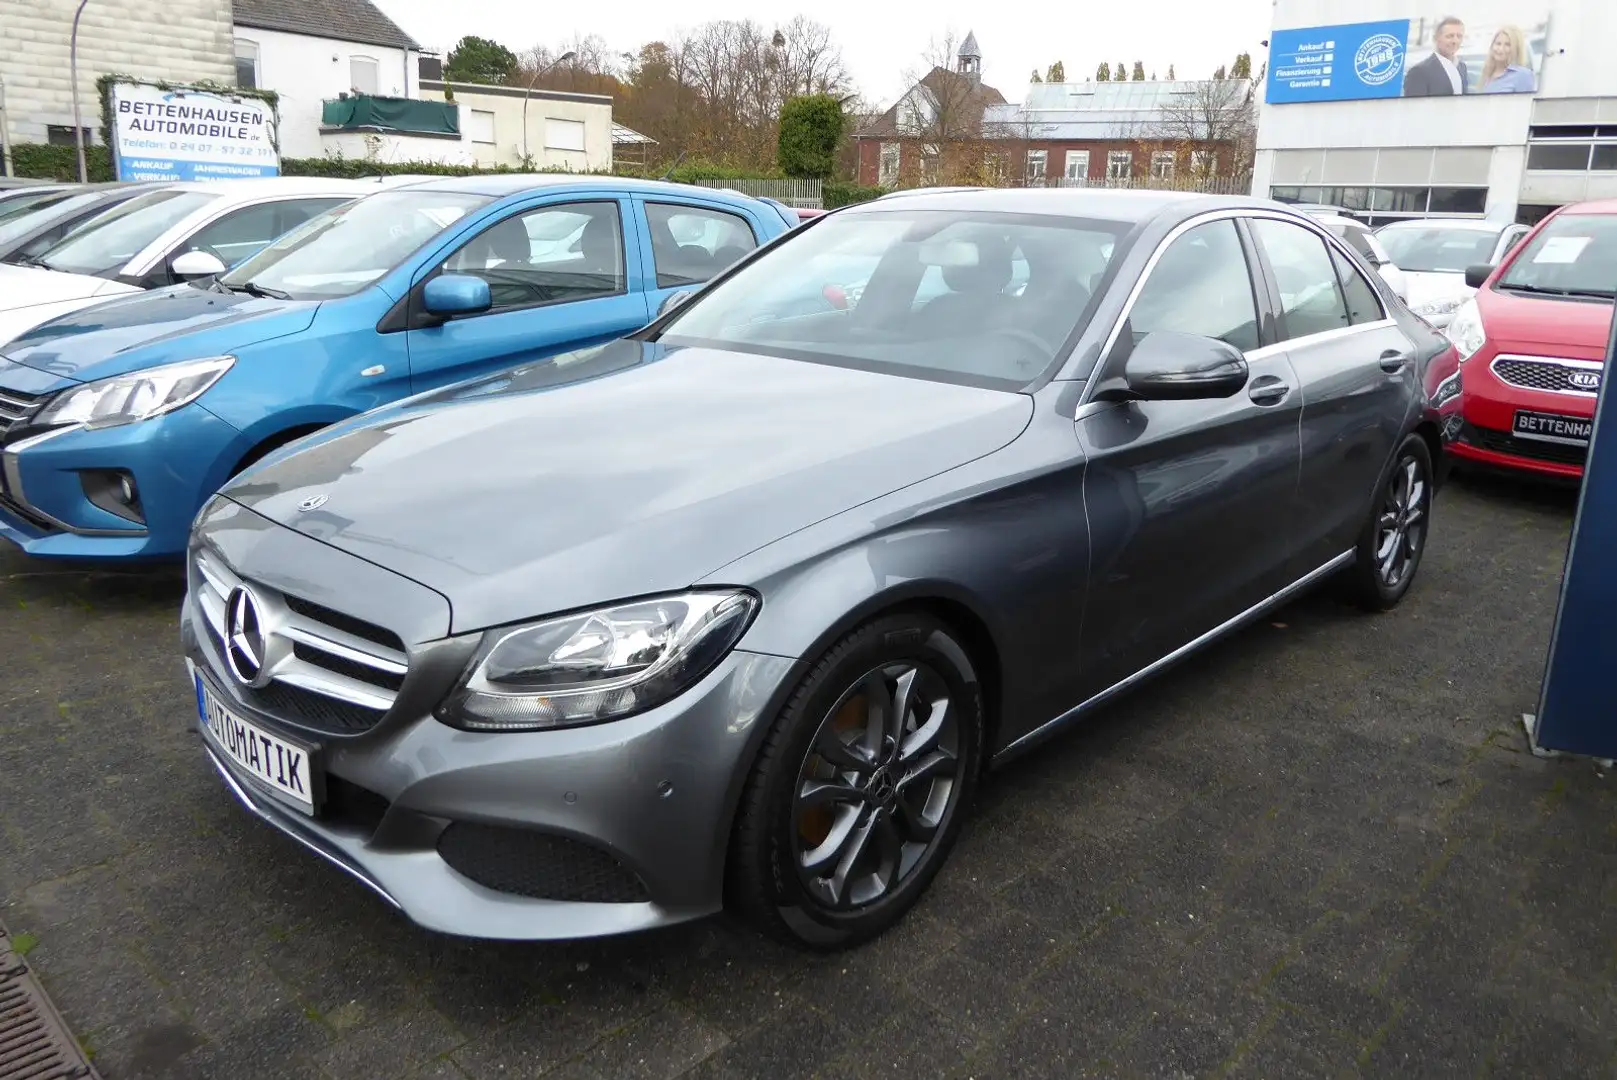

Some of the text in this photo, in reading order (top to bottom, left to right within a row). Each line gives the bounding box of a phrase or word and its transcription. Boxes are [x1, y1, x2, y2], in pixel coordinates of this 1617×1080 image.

[1298, 42, 1324, 51] Ankauf
[1295, 54, 1323, 63] Verkauf
[1276, 68, 1321, 76] Finanzierung
[1290, 80, 1320, 88] Garantie
[119, 100, 263, 125] BETTENHAUSEN
[129, 118, 248, 140] AUTOMOBILE
[122, 138, 165, 149] Telefon:
[199, 144, 212, 153] 07
[221, 145, 235, 155] 57
[239, 146, 253, 156] 32
[132, 160, 261, 176] ANKAUF JAHRESWAGEN
[133, 172, 180, 182] VERKAUF
[1573, 374, 1598, 385] KIA
[206, 690, 304, 794] AUTOMATIK
